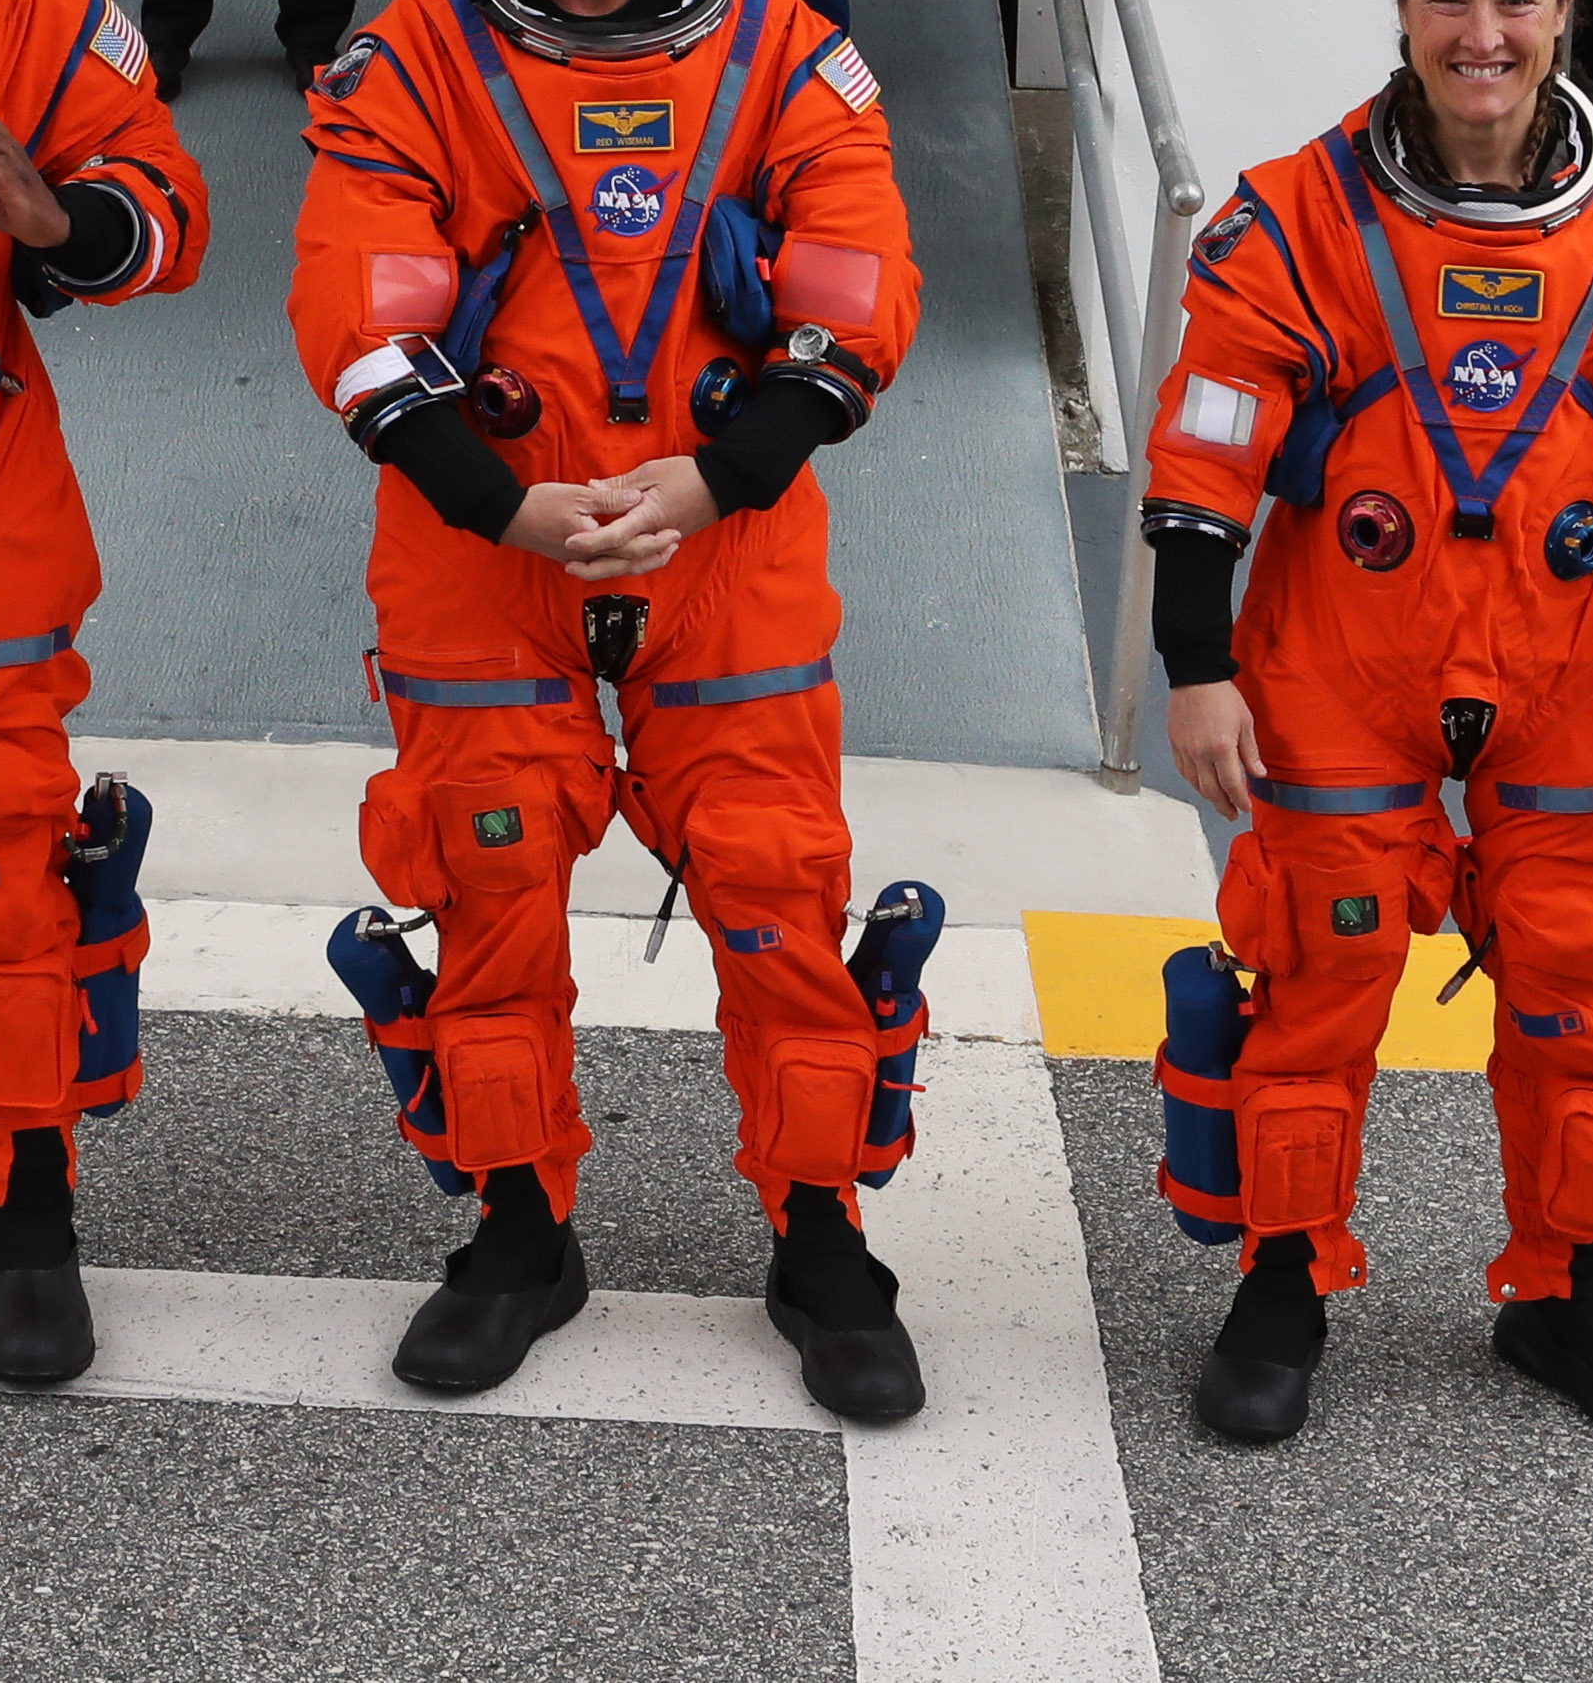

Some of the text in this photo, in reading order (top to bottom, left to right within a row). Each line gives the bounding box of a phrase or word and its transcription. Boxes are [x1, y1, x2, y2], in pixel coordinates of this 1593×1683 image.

[595, 136, 655, 147] REID WISEMAN
[597, 190, 661, 211] NASA
[1503, 304, 1524, 314] KOCH
[1452, 365, 1517, 387] NASA
